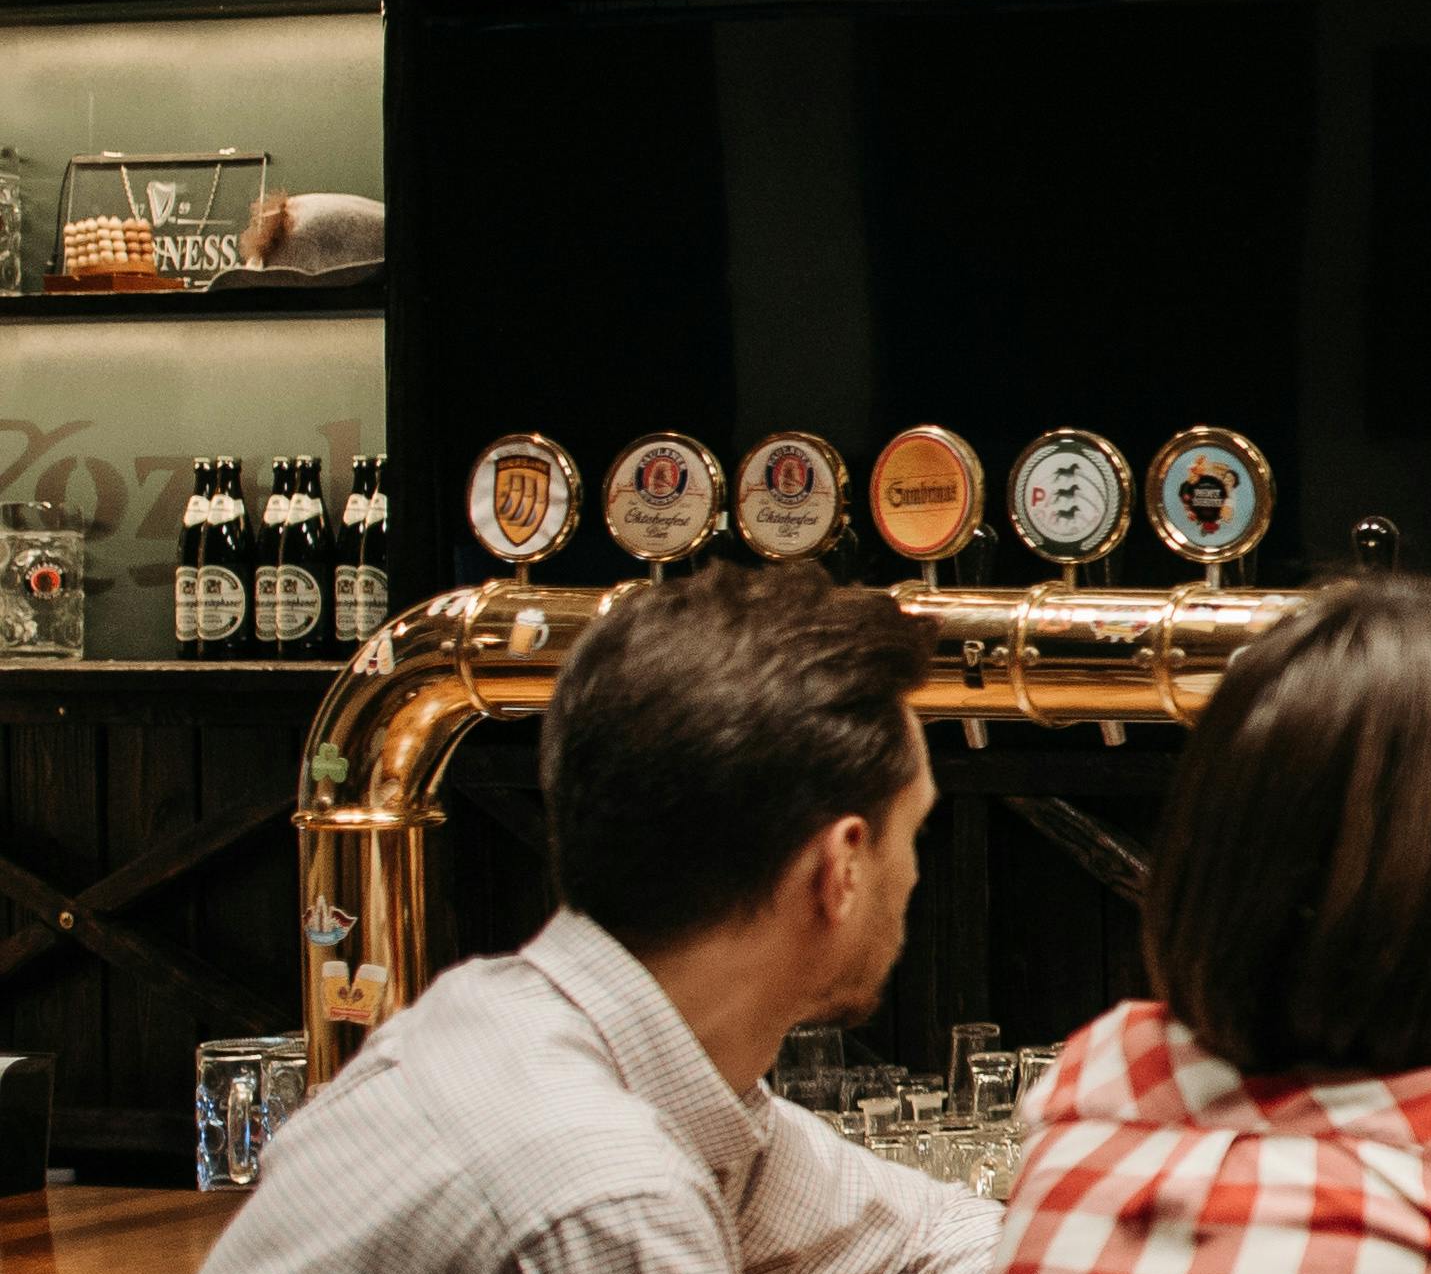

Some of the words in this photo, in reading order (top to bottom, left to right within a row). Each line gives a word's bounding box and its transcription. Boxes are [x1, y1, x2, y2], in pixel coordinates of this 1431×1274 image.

[152, 233, 238, 272] NESS
[623, 507, 690, 528] Oktoberfest
[755, 506, 819, 528] Oktoberfest
